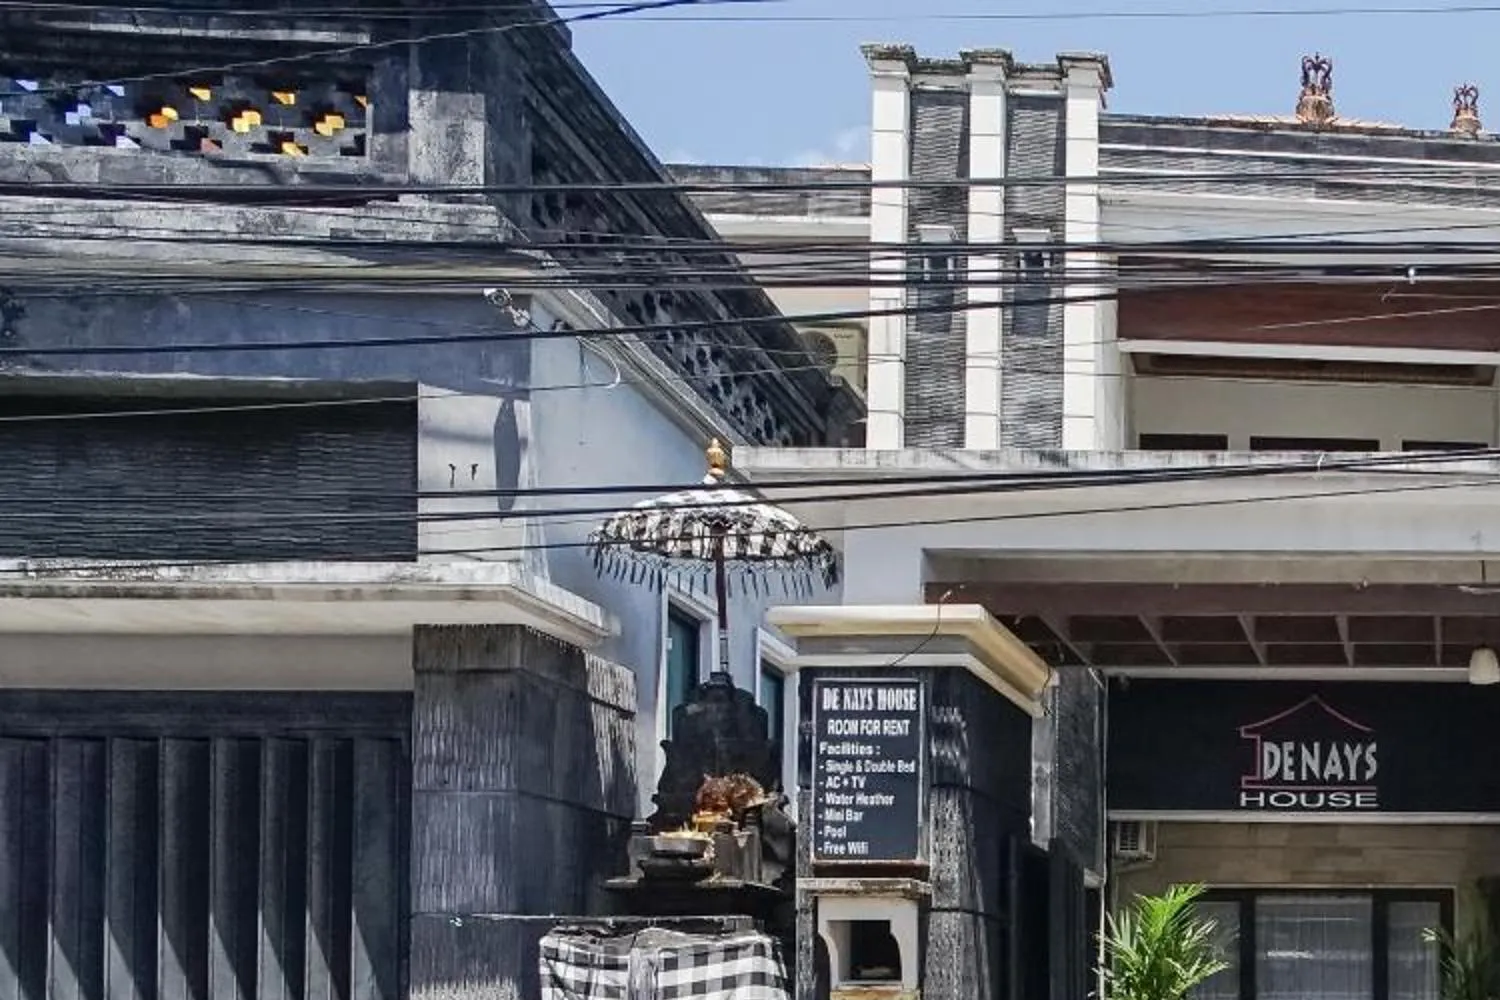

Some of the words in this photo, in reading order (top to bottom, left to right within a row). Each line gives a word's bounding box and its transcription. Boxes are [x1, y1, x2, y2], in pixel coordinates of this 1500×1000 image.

[823, 687, 839, 711] DE
[877, 687, 916, 711] HOUSE
[827, 719, 858, 735] ROOM
[860, 719, 880, 735] FOR
[883, 719, 910, 735] RENT
[819, 741, 873, 755] Facilities
[825, 759, 853, 775] Single
[864, 760, 896, 773] Double
[897, 760, 915, 773] Bed
[825, 776, 840, 789] AC
[851, 776, 867, 789] TV
[825, 792, 854, 805] Water
[1240, 791, 1379, 808] HOUSE
[824, 808, 845, 821] Mini
[846, 808, 864, 822] Bar
[824, 825, 847, 838] Pool
[824, 841, 846, 855] Free
